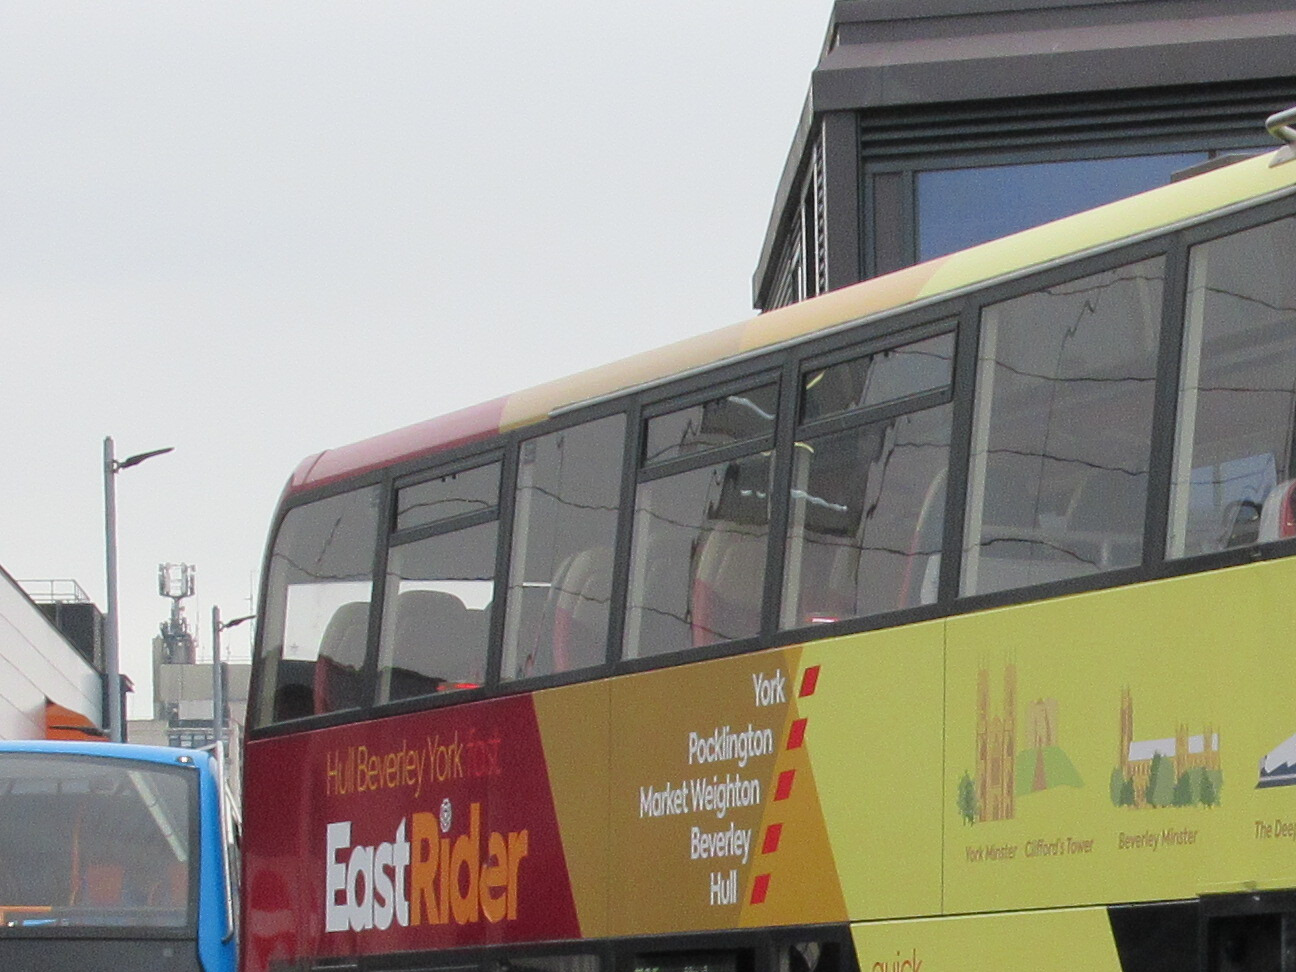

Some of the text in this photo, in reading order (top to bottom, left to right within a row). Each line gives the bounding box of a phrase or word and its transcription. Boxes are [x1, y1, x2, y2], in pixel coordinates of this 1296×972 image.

[752, 669, 787, 707] York
[326, 747, 355, 796] Hull
[357, 739, 426, 799] Beverley
[427, 730, 464, 784] York
[688, 724, 774, 768] Pocklington
[640, 773, 761, 818] Market Weighton
[690, 822, 752, 864] Beverley
[1066, 837, 1094, 855] Tower
[1118, 828, 1198, 851] Beverley Minster
[1254, 820, 1272, 839] The
[325, 797, 530, 933] EastRider
[966, 844, 1018, 862] York Minster
[710, 869, 738, 905] Hull
